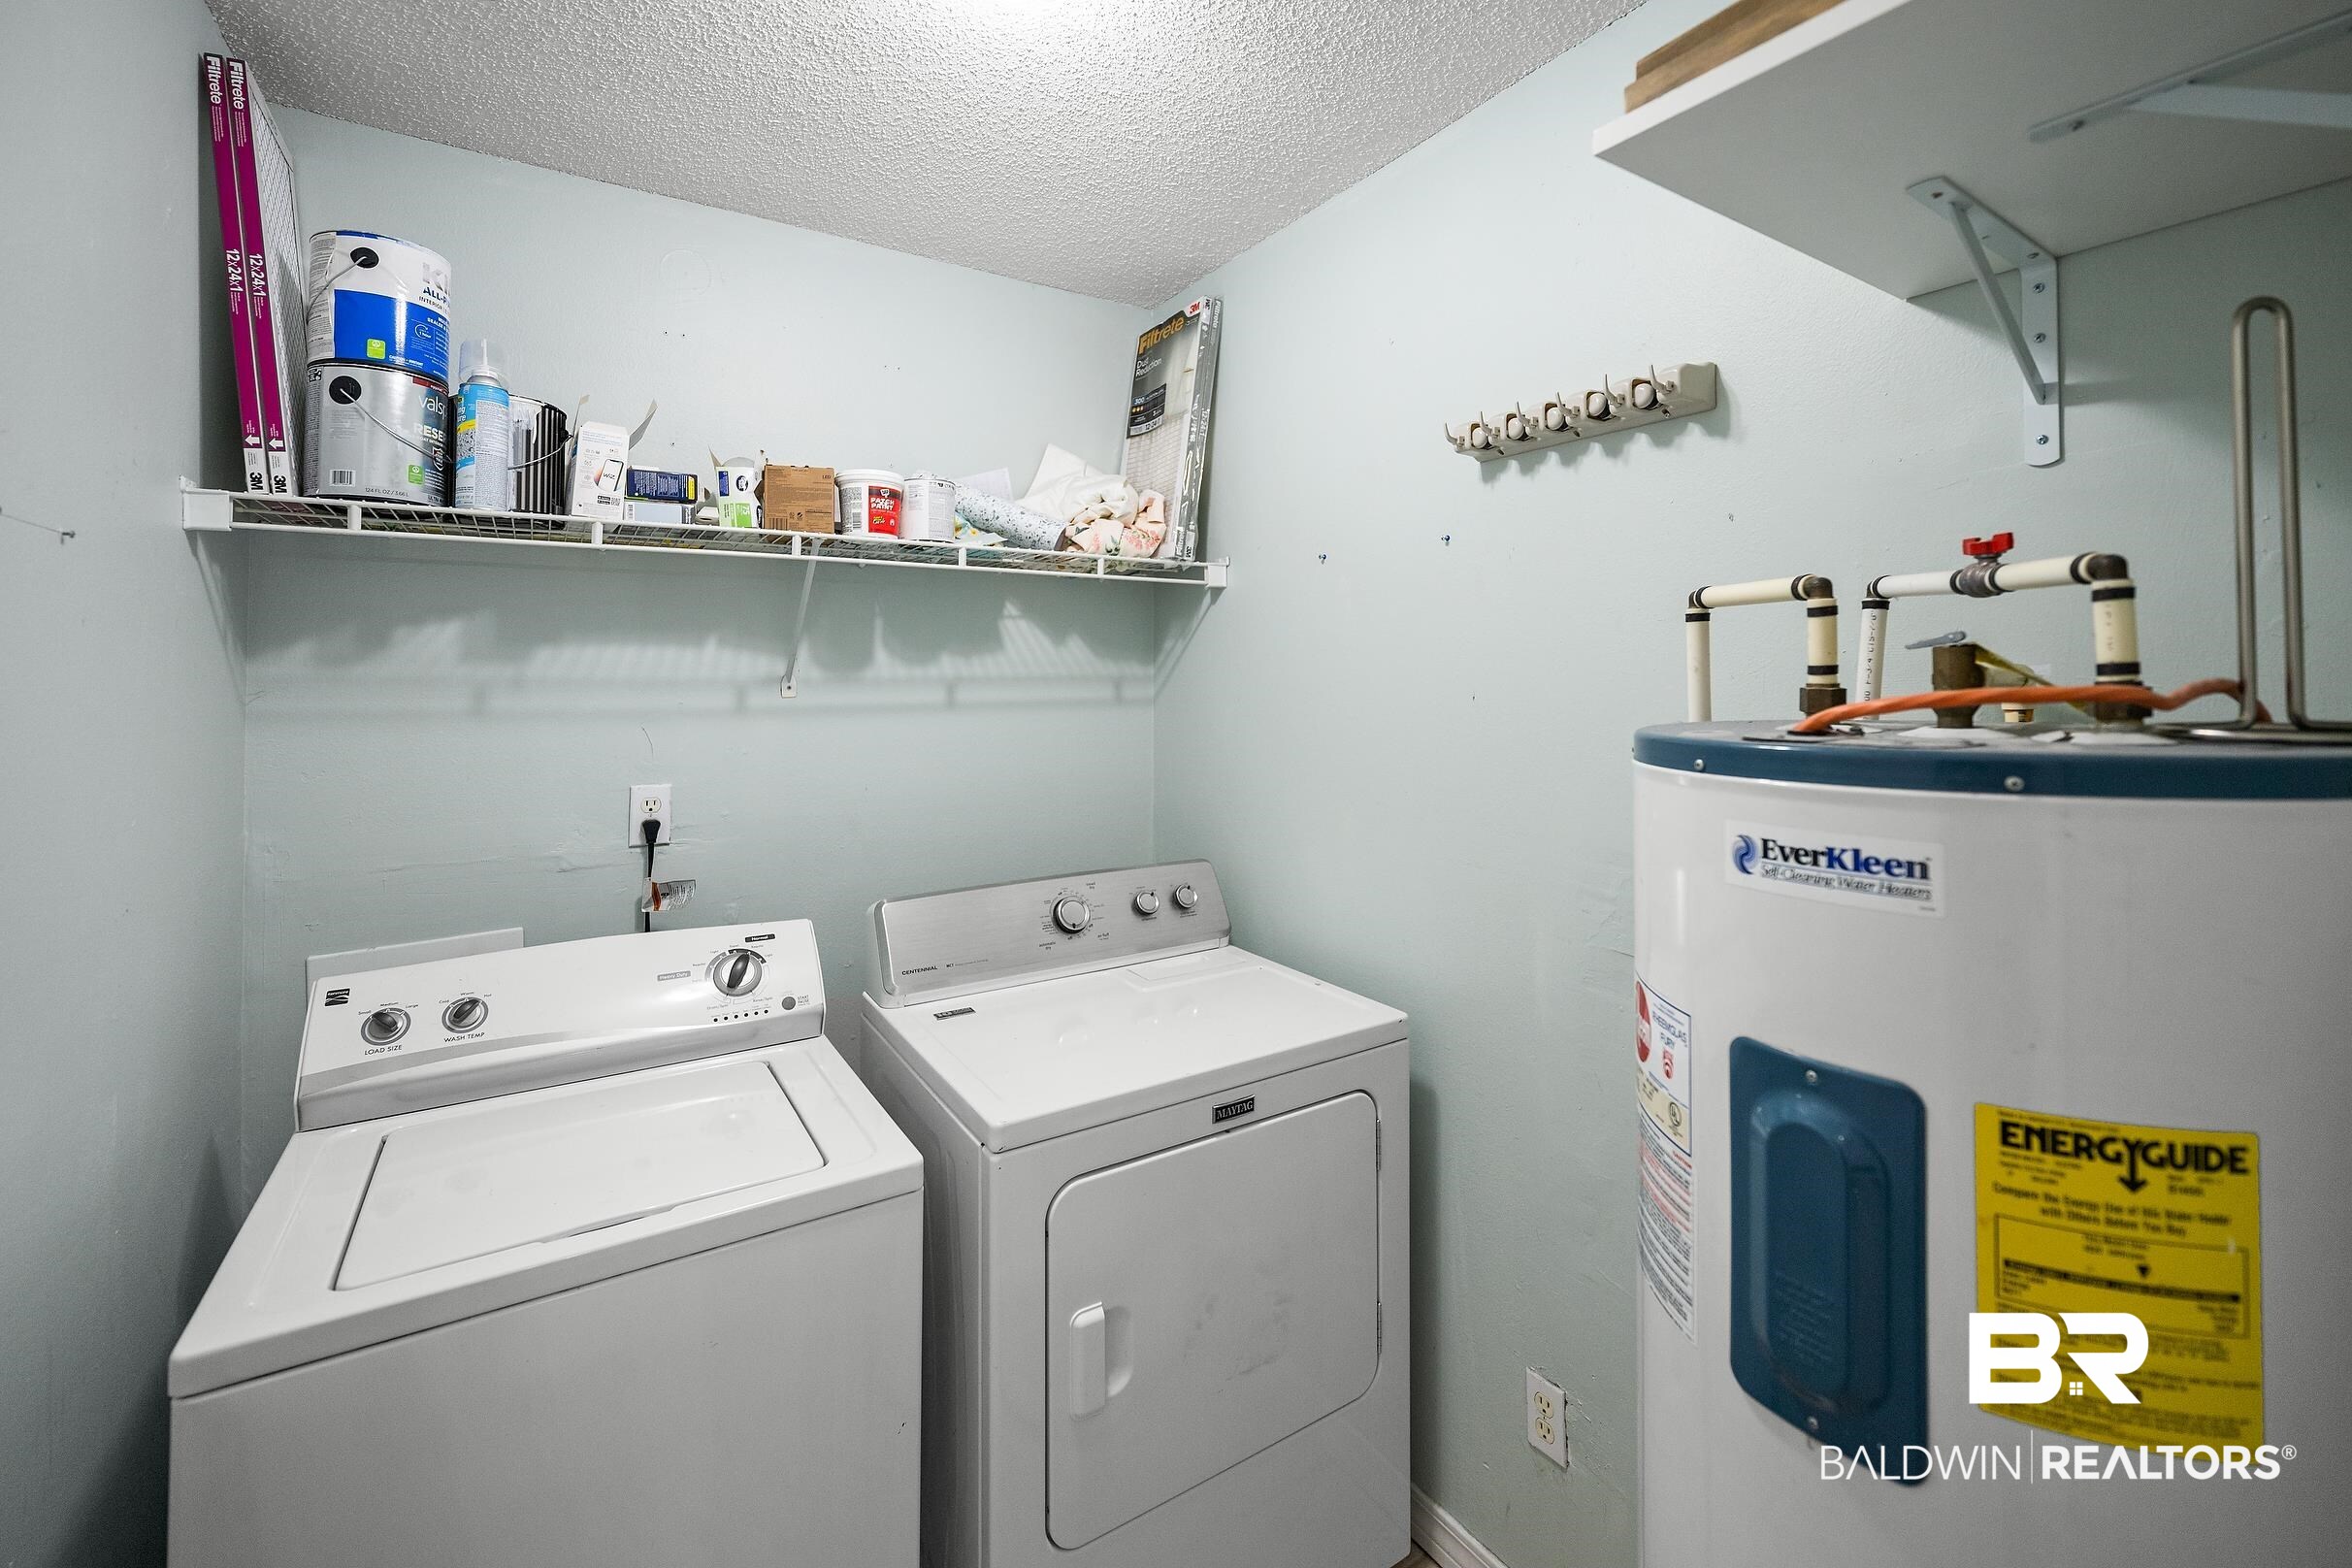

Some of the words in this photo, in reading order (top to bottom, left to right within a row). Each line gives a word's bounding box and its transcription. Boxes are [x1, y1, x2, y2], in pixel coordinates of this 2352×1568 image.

[207, 55, 223, 106] Filtrete
[229, 60, 246, 111] Filtrete
[226, 248, 244, 293] 12x24x1
[248, 253, 267, 297] 12x24x1
[1189, 301, 1201, 314] 3M
[1138, 316, 1185, 355] Filtrete
[249, 473, 264, 491] 3M
[274, 475, 288, 494] 3M
[870, 497, 895, 506] PATCH
[1761, 837, 1931, 881] EverKleen
[901, 965, 938, 976] CENTENNIAL
[443, 1034, 466, 1043] WASH
[364, 1047, 385, 1056] LOAD
[1216, 1100, 1253, 1120] MAYTAG
[1999, 1120, 2250, 1176] ENERGYGUIDE
